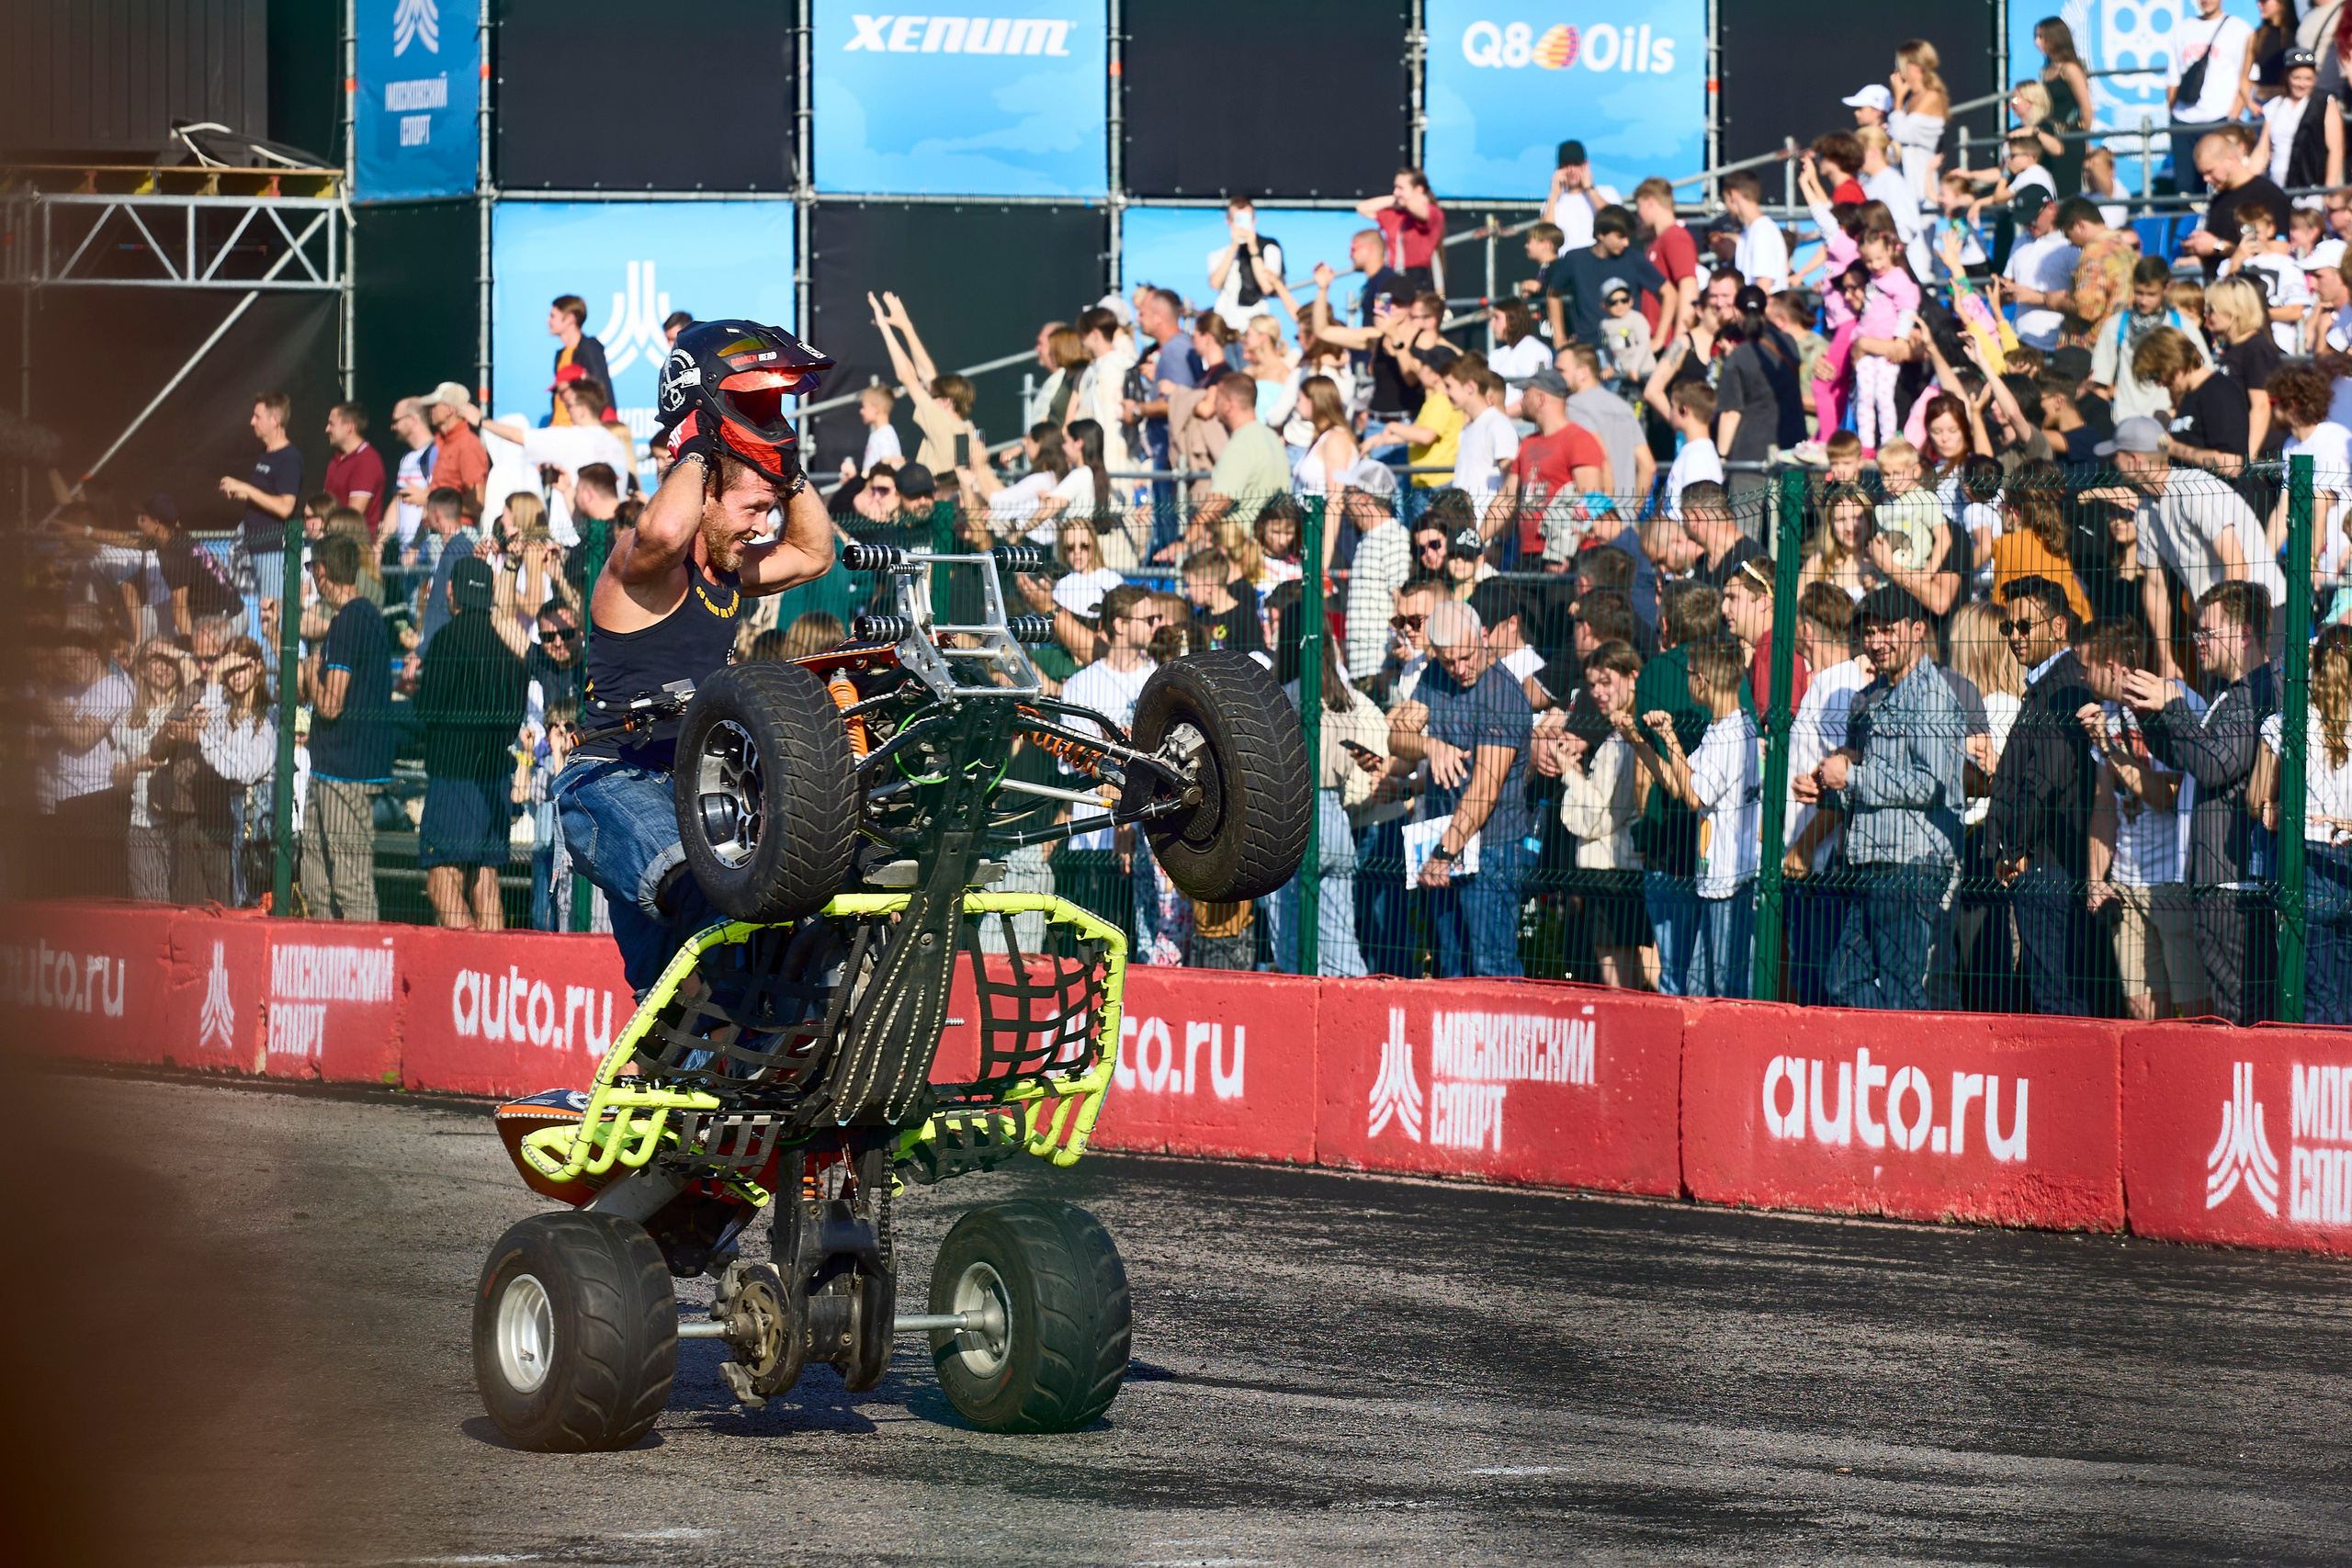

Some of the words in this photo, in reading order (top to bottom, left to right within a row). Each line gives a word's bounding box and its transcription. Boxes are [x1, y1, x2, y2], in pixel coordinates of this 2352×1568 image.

[842, 14, 1071, 57] XENUM
[1462, 20, 1533, 70] Q8
[1580, 24, 1675, 74] Oils
[385, 71, 448, 113] МОСКОВСКИЙ
[400, 114, 432, 147] СПОРТ
[758, 351, 777, 362] HEAD
[270, 937, 395, 1002] МОСКОВСКИЙ
[267, 1001, 327, 1058] СПОРТ
[453, 964, 614, 1058] auto.ru
[1431, 1006, 1596, 1086] МОСКОВСКИЙ
[1430, 1081, 1508, 1153] СПОРТ
[1763, 1048, 2030, 1163] auto.ru
